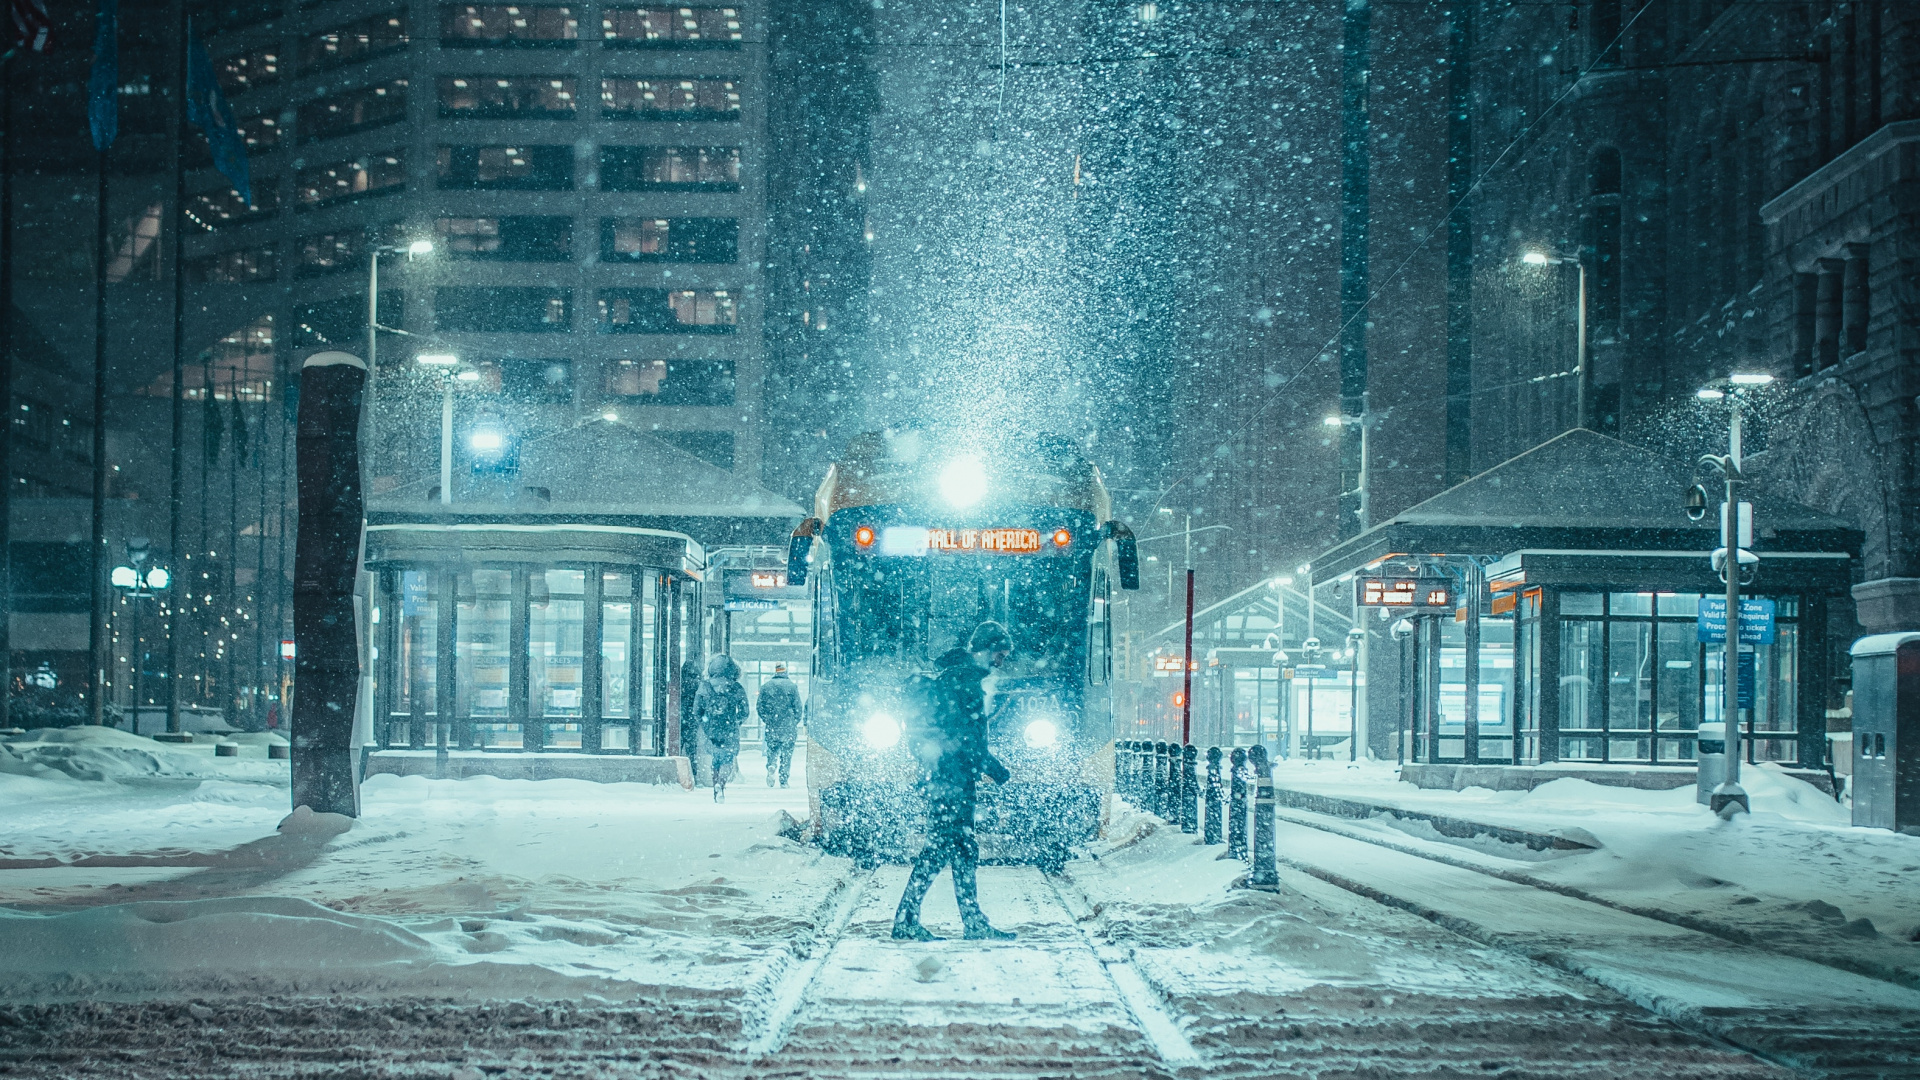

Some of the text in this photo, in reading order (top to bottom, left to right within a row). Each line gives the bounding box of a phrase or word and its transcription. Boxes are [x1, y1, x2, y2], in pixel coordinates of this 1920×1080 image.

[962, 530, 977, 549] OF
[981, 530, 1038, 549] AMERICA
[1703, 611, 1719, 619] Valid
[1738, 613, 1769, 621] Required
[1706, 622, 1727, 630] Proce
[1741, 632, 1761, 640] ahead
[1018, 696, 1060, 711] 107A
